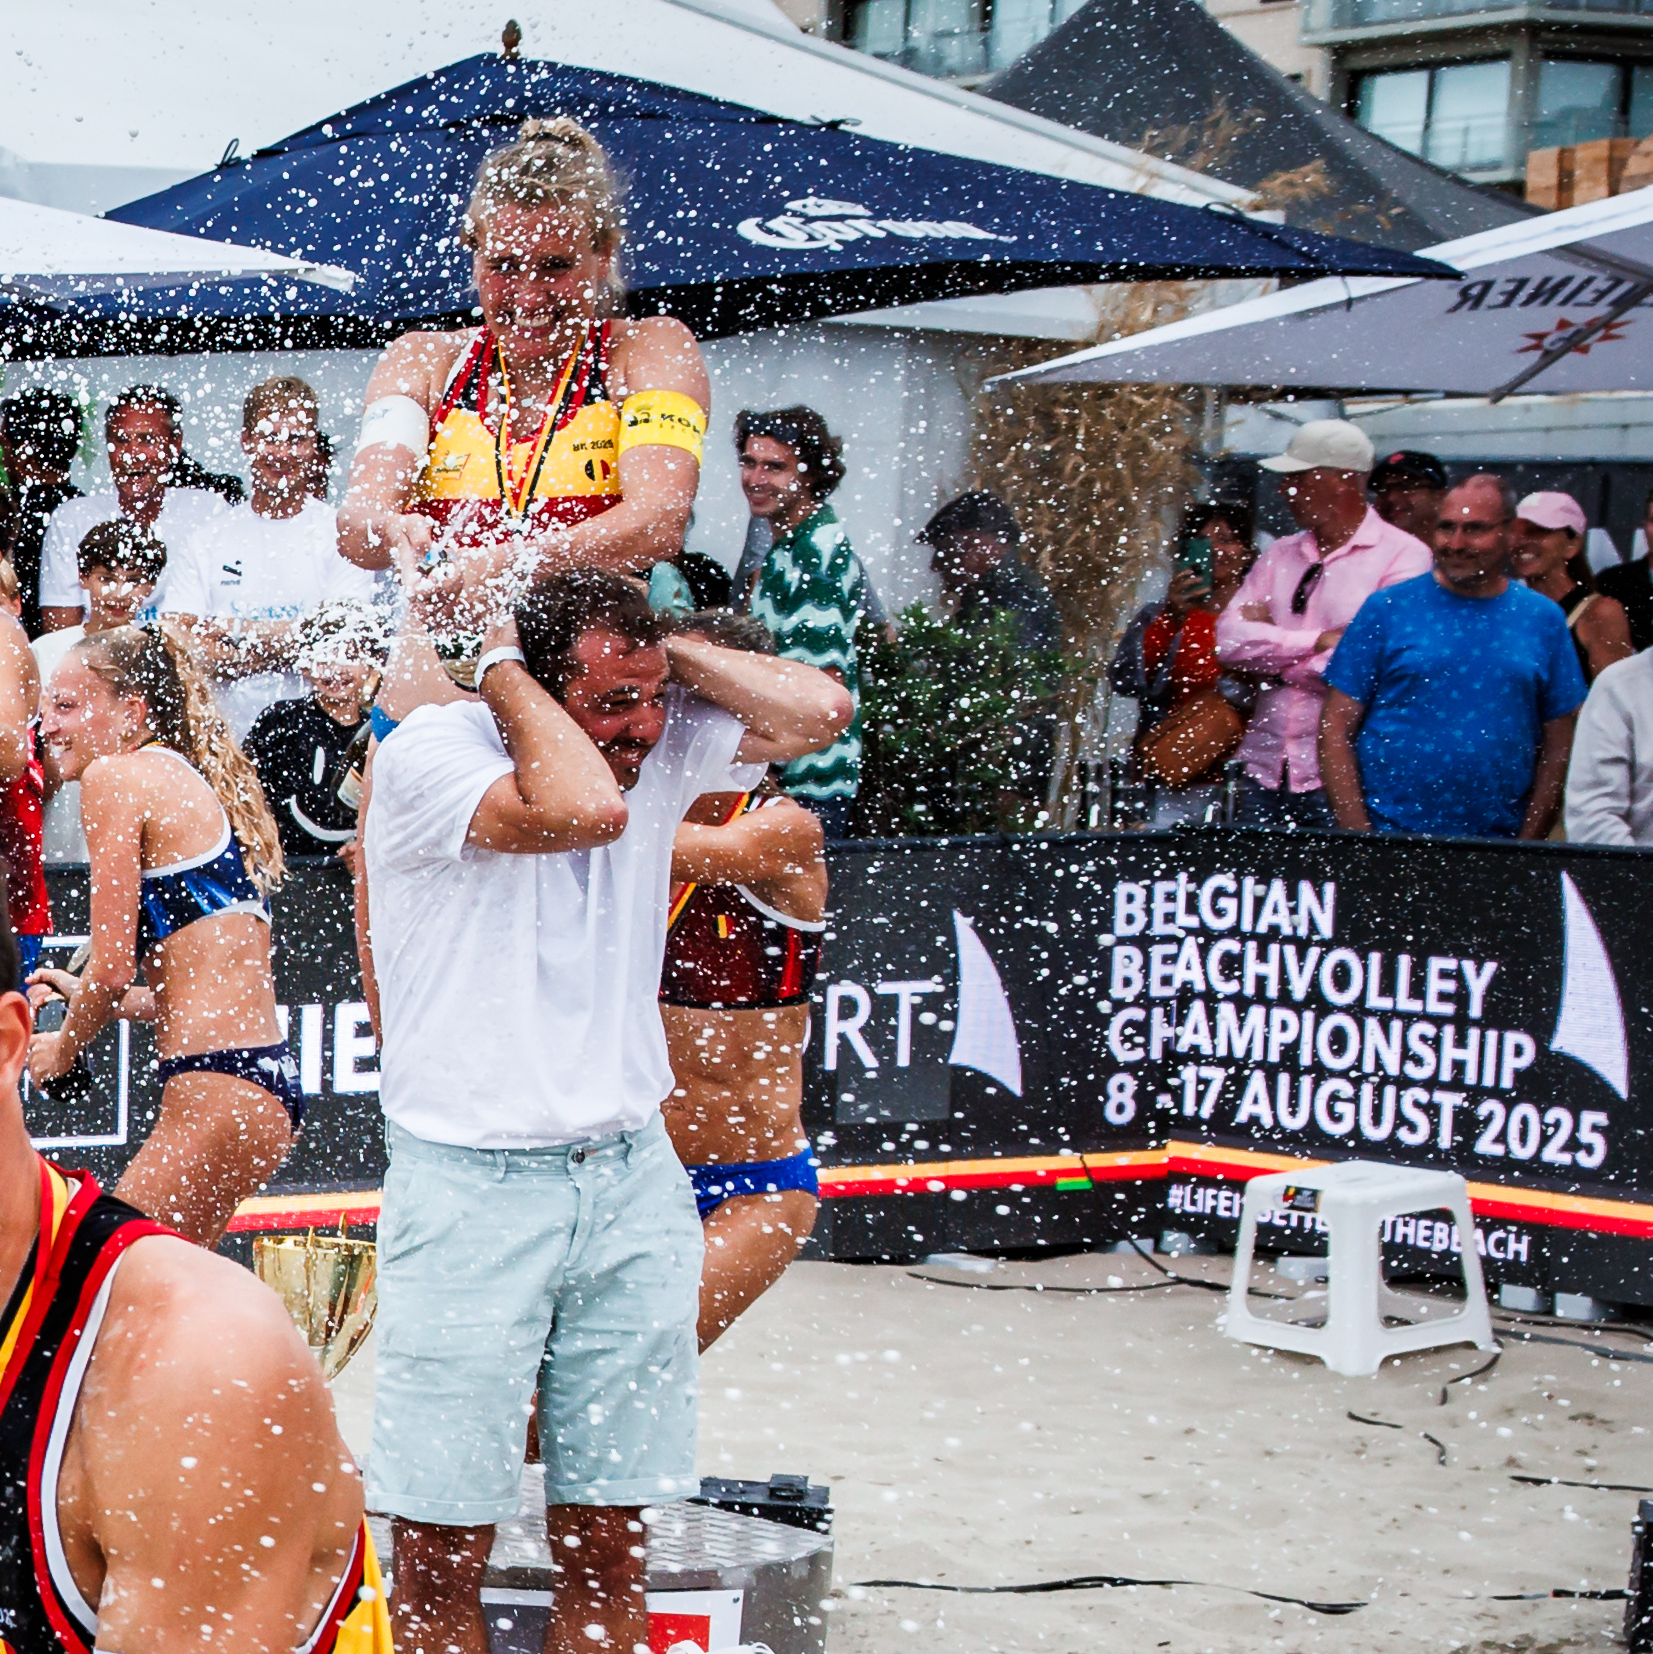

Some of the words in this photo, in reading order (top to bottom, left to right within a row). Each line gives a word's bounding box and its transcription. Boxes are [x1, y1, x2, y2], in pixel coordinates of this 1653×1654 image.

[737, 215, 997, 251] Corona
[1113, 871, 1336, 939] BELGIAN
[1110, 935, 1498, 1020] BEACHVOLLEY
[1108, 1000, 1537, 1089] CHAMPIONSHIP
[1104, 1073, 1136, 1126] 8
[1180, 1066, 1226, 1120] 17
[1235, 1068, 1464, 1151] AUGUST
[1473, 1098, 1610, 1170] 2025
